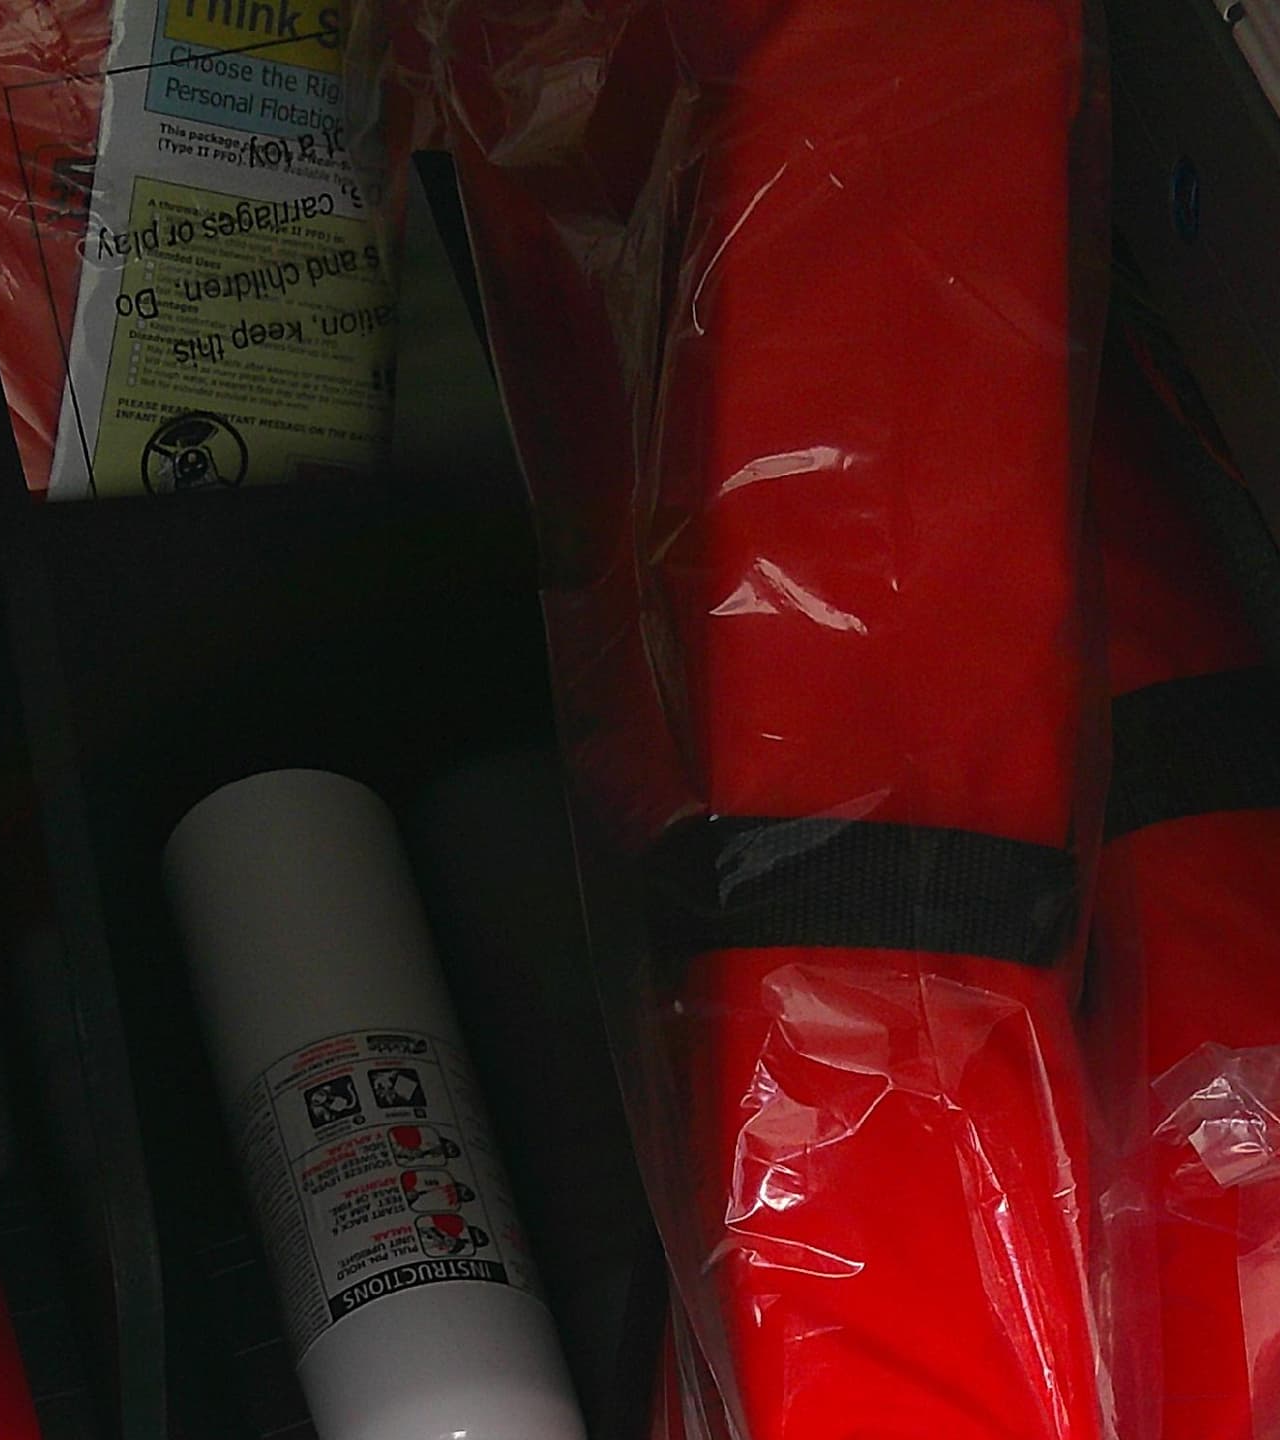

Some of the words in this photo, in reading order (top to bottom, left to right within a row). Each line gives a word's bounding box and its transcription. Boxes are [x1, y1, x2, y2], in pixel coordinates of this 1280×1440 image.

[170, 46, 254, 82] Choose
[262, 65, 299, 93] the
[306, 75, 344, 106] Rig
[166, 77, 254, 115] Personal
[158, 138, 194, 155] (Type
[160, 122, 186, 138] This
[188, 131, 241, 151] package
[299, 133, 314, 158] a
[201, 193, 334, 239] carriages
[98, 217, 160, 261] play
[167, 220, 195, 247] or
[175, 261, 300, 302] children.
[306, 249, 358, 288] and
[115, 288, 159, 319] Do
[231, 319, 302, 350] keep
[172, 334, 226, 368] this
[117, 397, 159, 412] PLEASE
[392, 1243, 419, 1257] PULL
[336, 1259, 367, 1281] HOLD
[342, 1260, 491, 1310] INSTRUCTIONS
